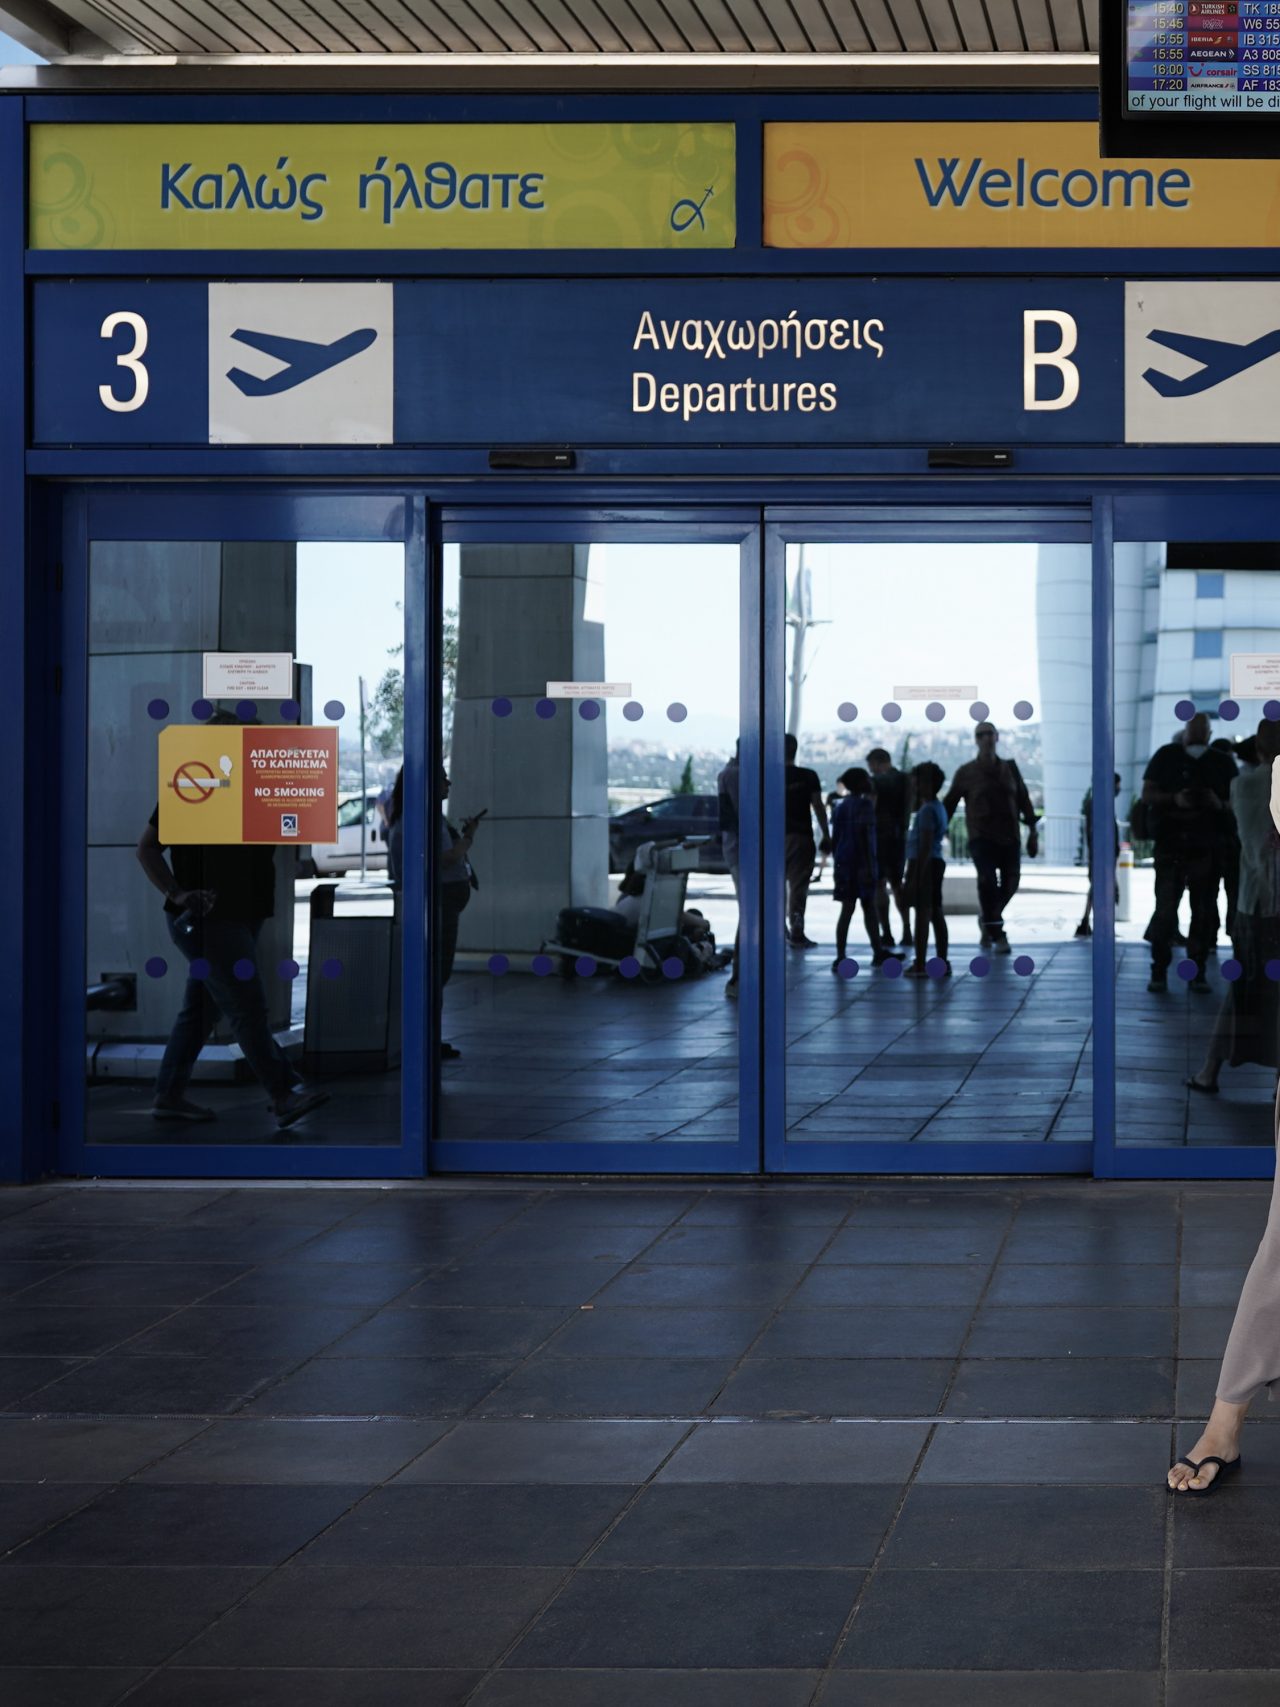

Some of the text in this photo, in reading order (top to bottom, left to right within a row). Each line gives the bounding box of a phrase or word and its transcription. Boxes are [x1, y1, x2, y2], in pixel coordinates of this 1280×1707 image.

[1244, 3, 1260, 14] TK
[1153, 18, 1183, 29] 15:45
[1243, 19, 1262, 30] W6
[1153, 34, 1183, 44] 15:55
[1243, 34, 1255, 45] IB
[1153, 49, 1183, 60] 15:55
[1191, 50, 1227, 58] AEGEAN
[1242, 49, 1258, 60] A3
[1152, 64, 1183, 75] 16:00
[1206, 68, 1237, 76] corsair
[1243, 65, 1259, 75] SS
[1152, 80, 1183, 90] 17:20
[1243, 80, 1259, 90] AF
[1132, 94, 1145, 107] of
[1150, 97, 1179, 110] your
[1184, 94, 1216, 110] flight
[1220, 95, 1241, 107] will
[1247, 95, 1263, 107] be
[914, 158, 1191, 208] Welcome
[161, 156, 545, 224] Καλώς ήλθατε
[633, 309, 885, 359] Αναχωρήσεις
[99, 310, 150, 412] 3
[1023, 309, 1080, 411] B
[632, 372, 836, 422] Departures
[250, 749, 329, 758] ΑΠΑΓΟΡΕΥΕΤΑΙ
[252, 759, 327, 768] ΤΟ ΚΑΠΝΙΣΜΑ
[254, 787, 325, 797] NO SMOKING
